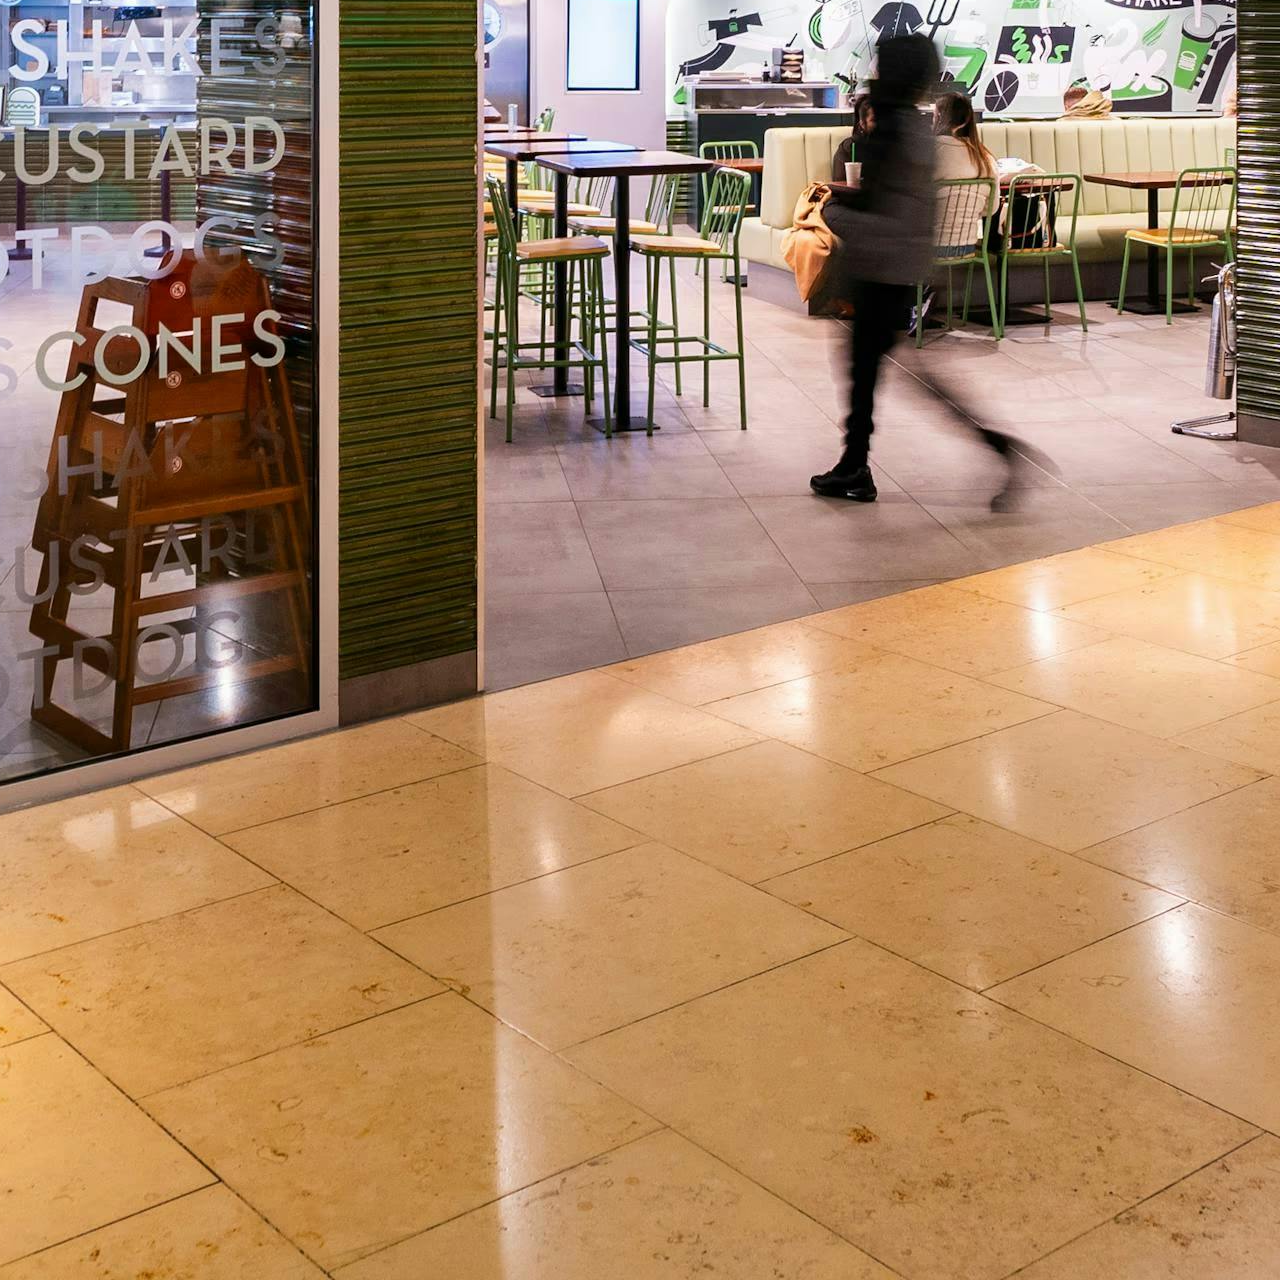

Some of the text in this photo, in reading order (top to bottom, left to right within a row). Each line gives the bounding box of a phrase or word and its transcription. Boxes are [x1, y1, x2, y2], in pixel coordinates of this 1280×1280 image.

[10, 19, 287, 82] SHAKES
[36, 310, 287, 392] CONES
[16, 410, 287, 503] SHAKS
